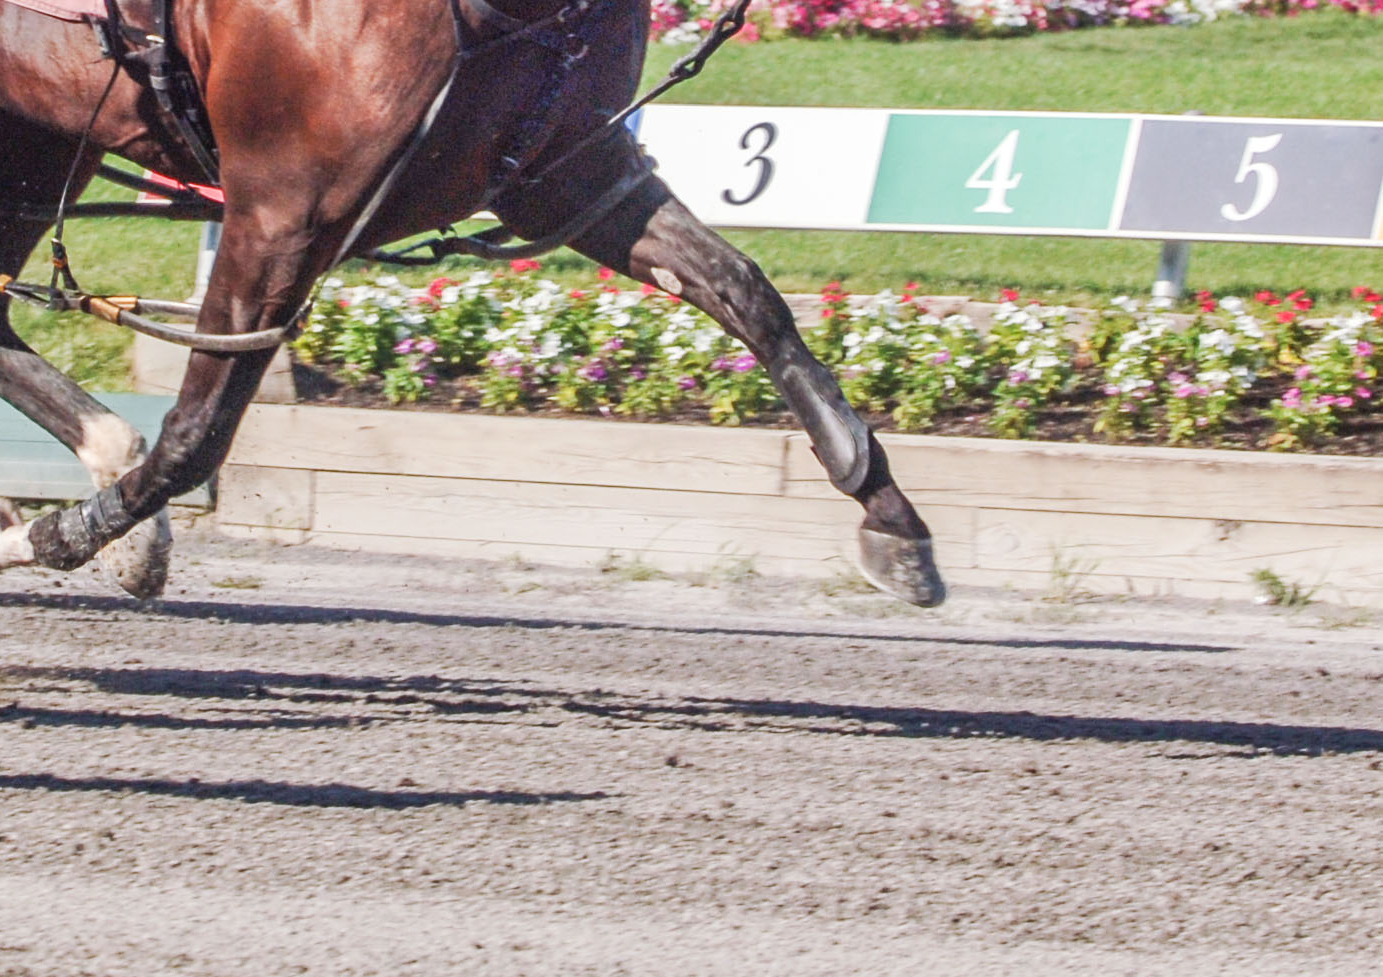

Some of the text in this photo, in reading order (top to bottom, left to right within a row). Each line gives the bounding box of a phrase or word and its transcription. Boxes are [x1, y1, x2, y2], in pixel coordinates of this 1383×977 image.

[721, 122, 778, 207] 3
[964, 129, 1023, 214] 4
[1220, 133, 1283, 222] 5
